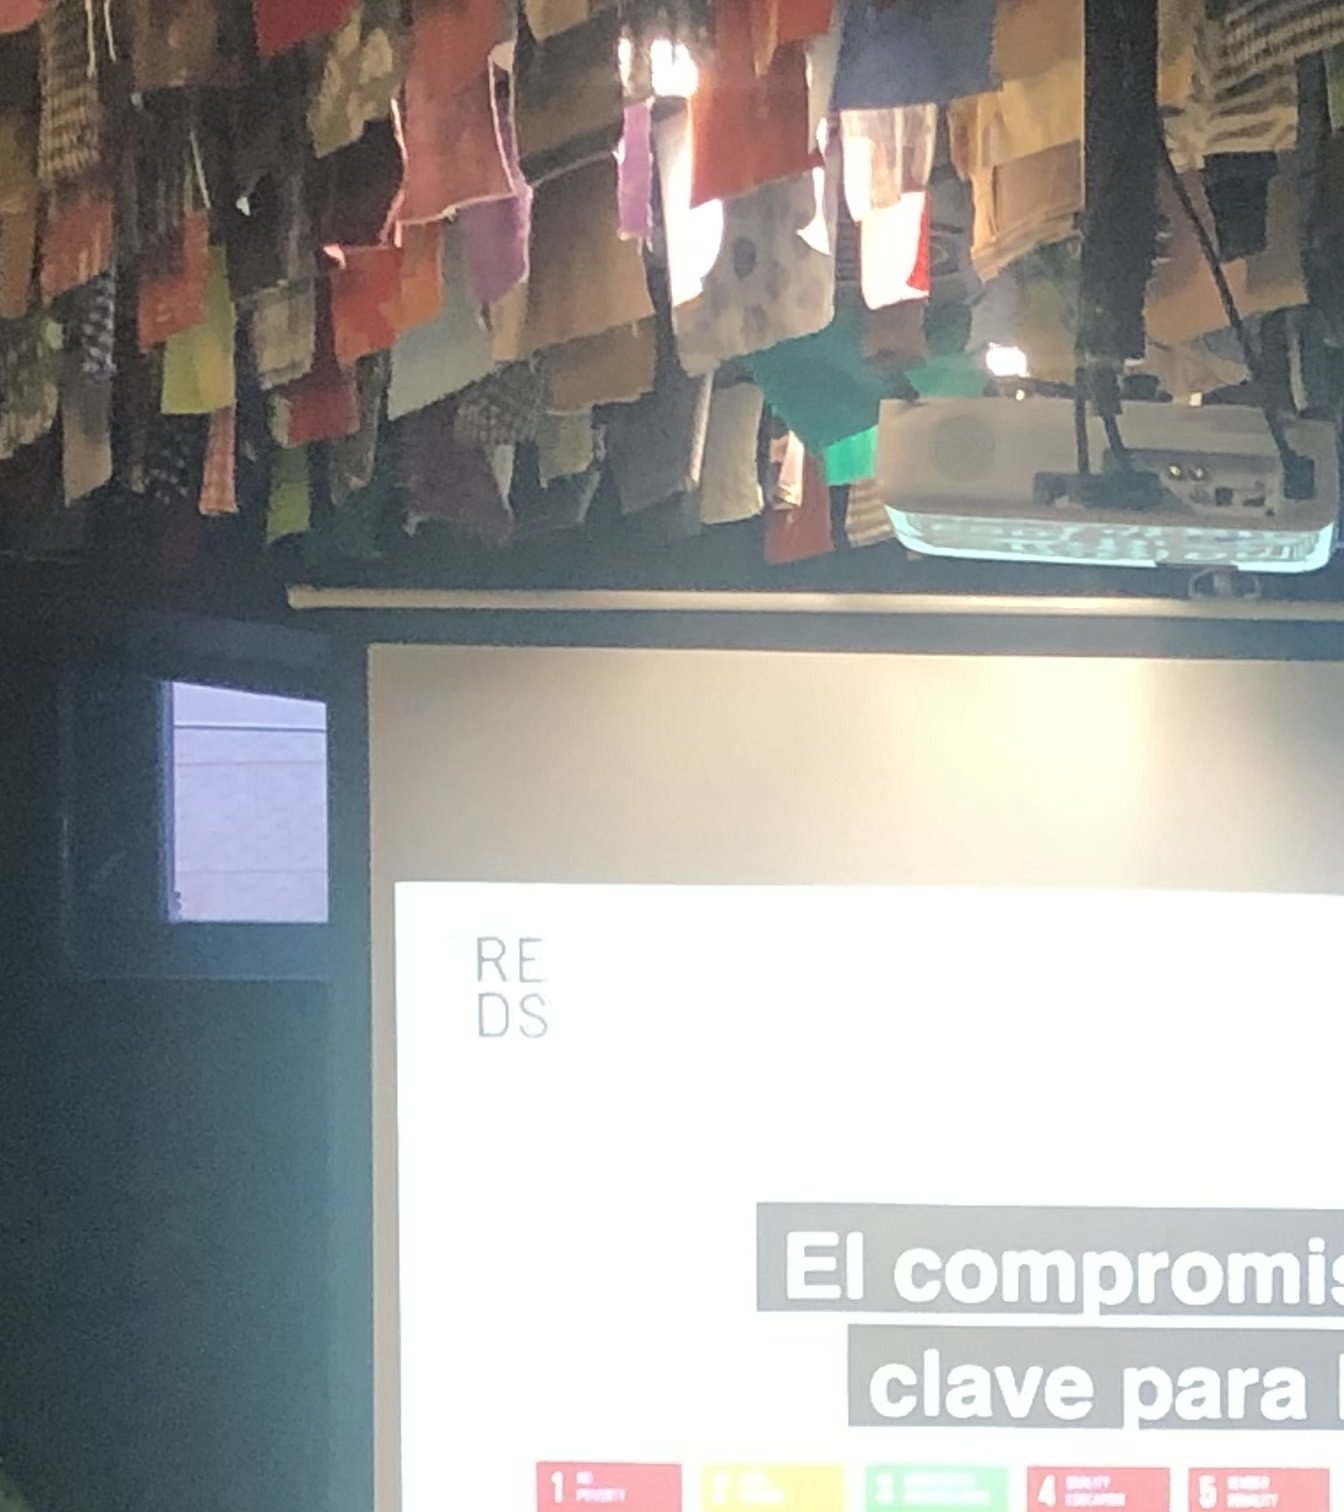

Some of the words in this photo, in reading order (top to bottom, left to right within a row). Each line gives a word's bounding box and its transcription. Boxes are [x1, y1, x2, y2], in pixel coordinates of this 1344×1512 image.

[477, 936, 548, 983] RE
[478, 992, 548, 1038] DS
[785, 1231, 865, 1300] El
[869, 1349, 1094, 1420] clave
[1122, 1365, 1308, 1432] para
[551, 1471, 564, 1504] 1
[1036, 1475, 1056, 1507] 4
[1198, 1475, 1217, 1509] 5
